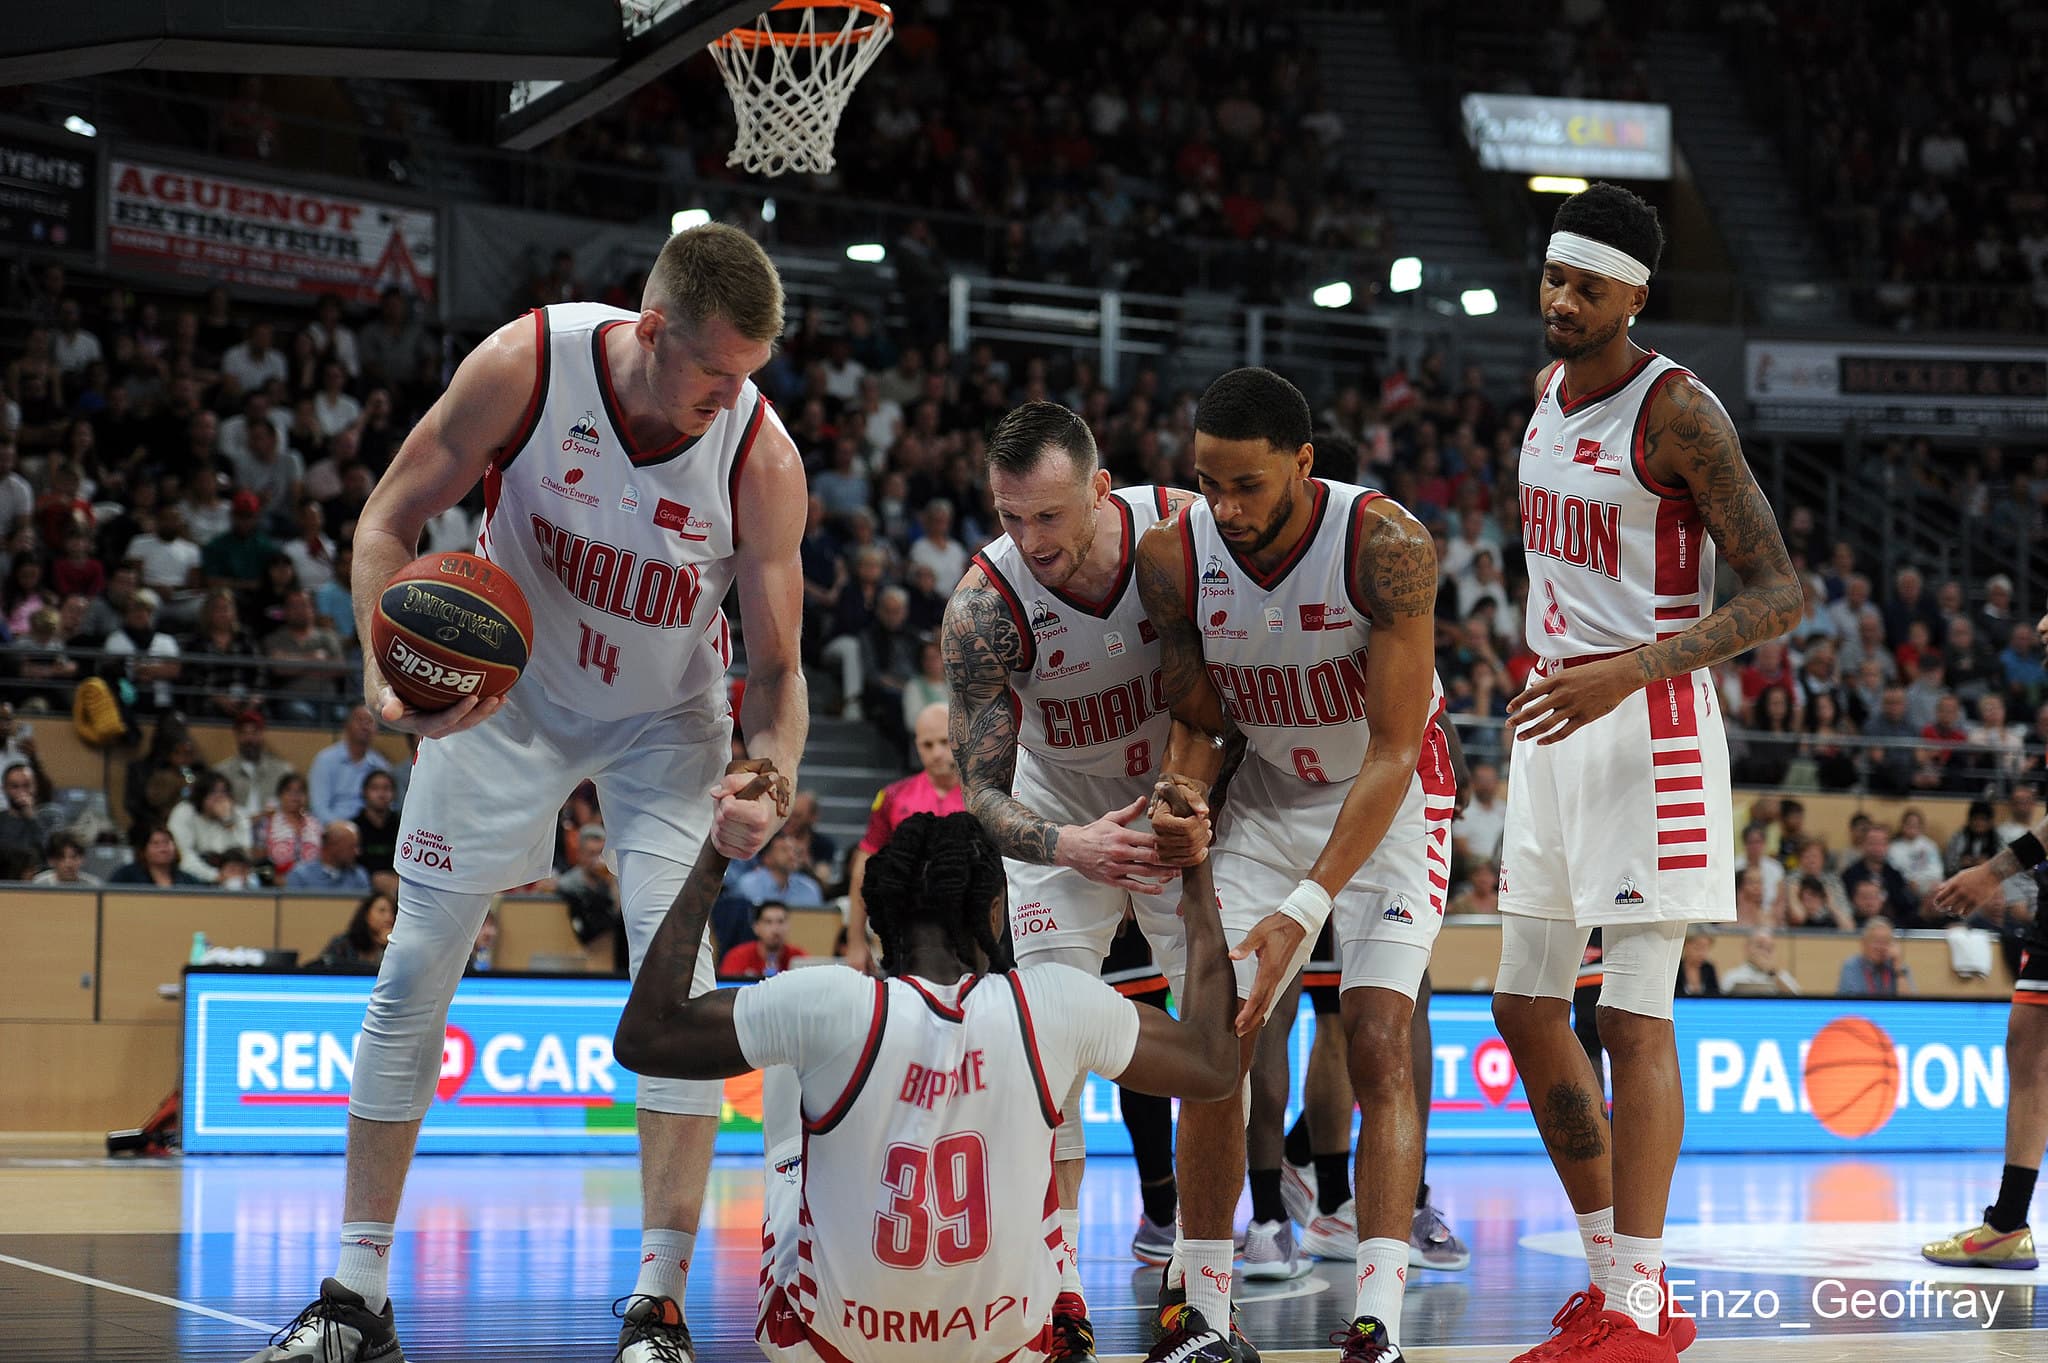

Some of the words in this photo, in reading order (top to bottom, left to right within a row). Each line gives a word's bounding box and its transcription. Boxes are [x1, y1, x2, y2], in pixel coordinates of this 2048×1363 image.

[117, 165, 361, 231] AGUENOT
[116, 201, 361, 258] EXTINCTEUR
[573, 442, 600, 457] Sports
[1519, 480, 1621, 582] HALON
[1678, 520, 1688, 569] RESPECT
[530, 513, 702, 629] CHALON
[1209, 587, 1235, 598] Sports
[403, 585, 508, 648] SPALDING
[1042, 625, 1068, 640] Sports
[392, 645, 481, 693] Betclic
[577, 616, 621, 688] 14
[1037, 667, 1170, 749] CHALO
[1204, 646, 1369, 728] CHALON
[1125, 738, 1152, 777] 8
[1291, 747, 1331, 784] 6
[415, 836, 453, 852] SANTENAY
[416, 828, 444, 842] CASINO
[413, 848, 453, 872] JOA
[1017, 902, 1041, 912] CASINO
[1017, 908, 1052, 919] SANTENAY
[1021, 917, 1058, 936] JOA
[235, 1030, 360, 1092] REN
[481, 1034, 616, 1093] CAR
[1696, 1038, 2006, 1113] PAION
[873, 1130, 992, 1270] 39
